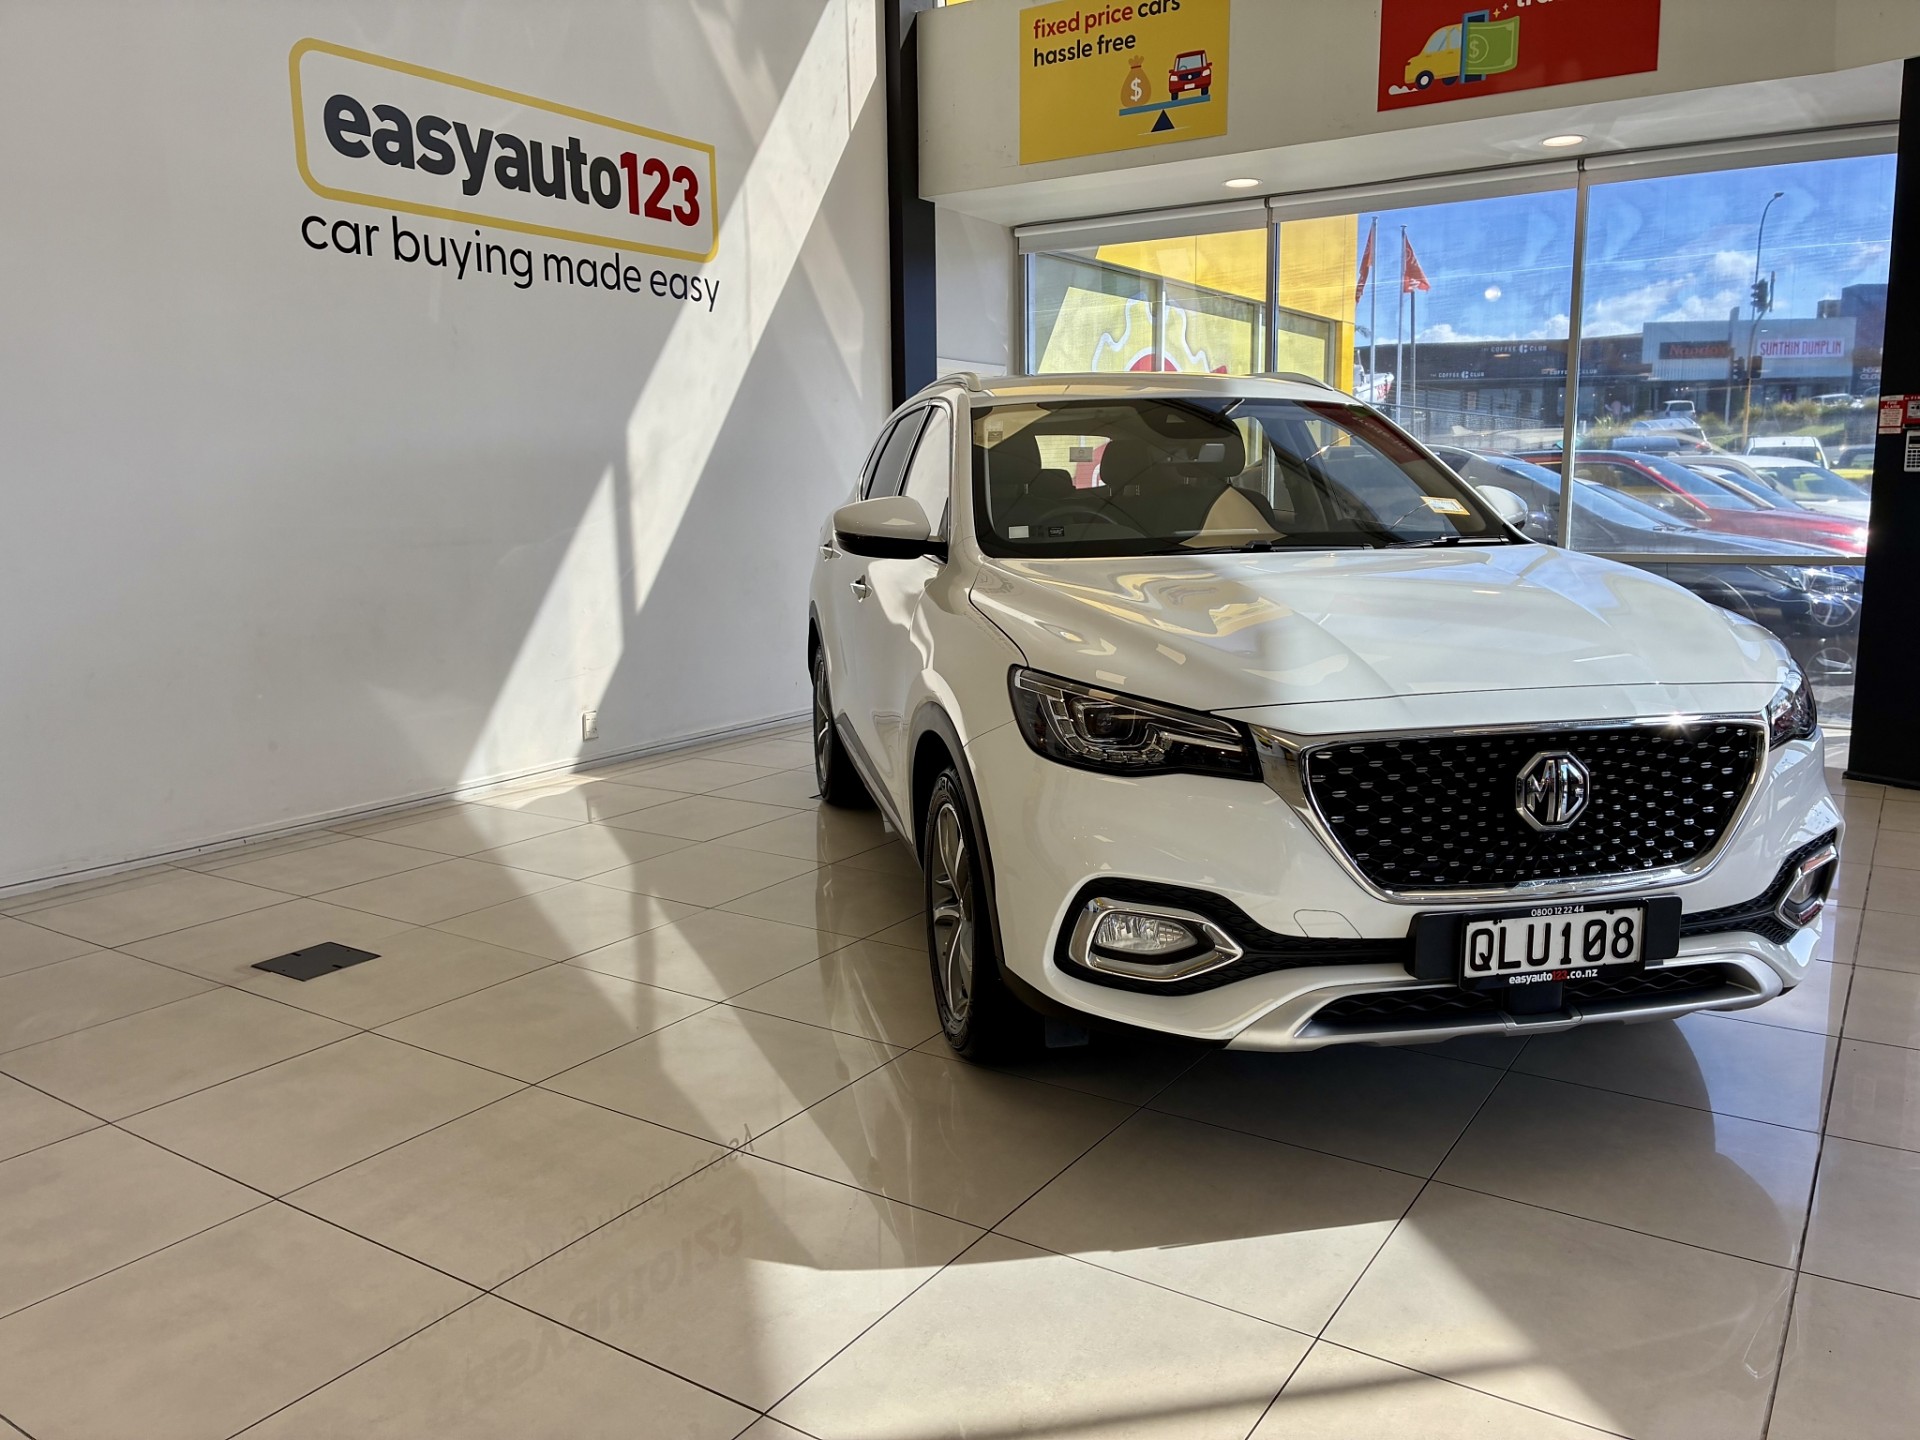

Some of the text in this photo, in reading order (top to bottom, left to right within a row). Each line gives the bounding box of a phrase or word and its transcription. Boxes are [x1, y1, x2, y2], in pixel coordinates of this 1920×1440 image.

[1033, 0, 1181, 39] fixed price cars
[1033, 34, 1136, 67] hassle free
[323, 94, 700, 227] easyauto123
[301, 215, 720, 312] car buying made easy
[1526, 759, 1584, 822] MG
[1531, 905, 1584, 917] 0800 12 22 44
[1469, 916, 1634, 971] QLU108
[1509, 968, 1598, 984] easyauto123.co.nz
